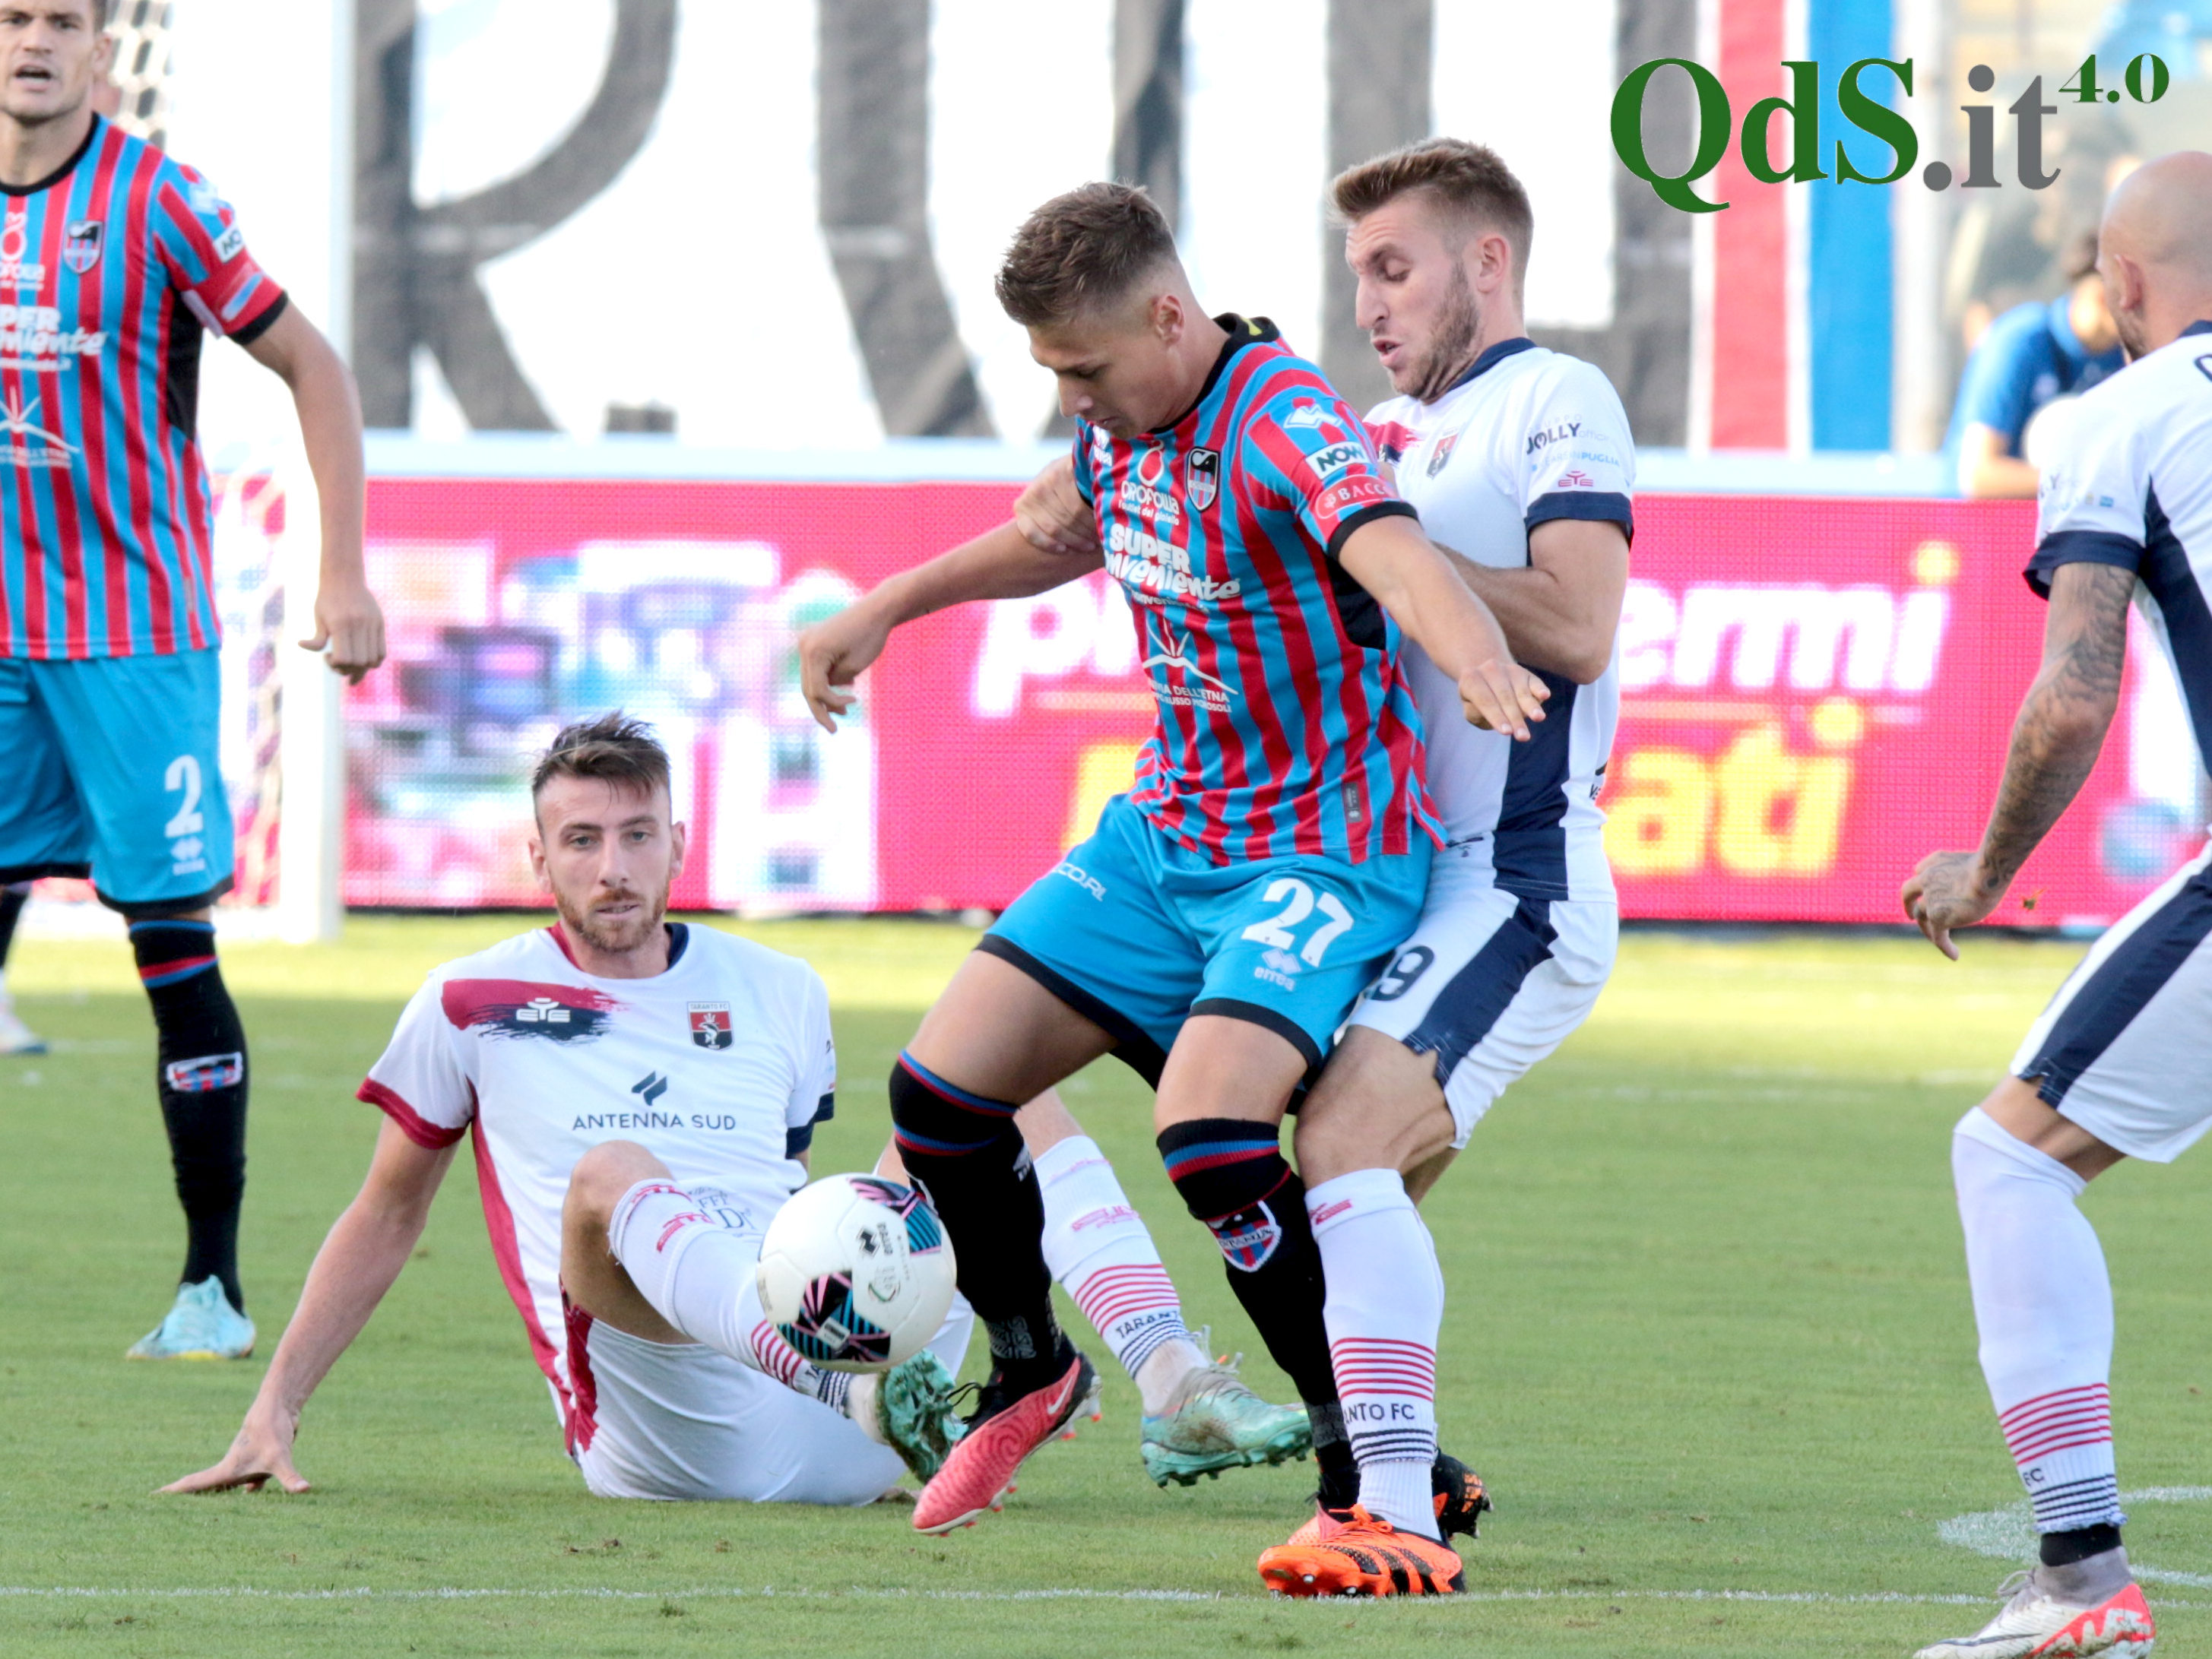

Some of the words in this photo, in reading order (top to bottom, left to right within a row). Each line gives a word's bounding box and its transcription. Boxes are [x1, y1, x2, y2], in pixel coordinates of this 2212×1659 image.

[1526, 423, 1581, 455] JOLLY
[1316, 445, 1366, 472] NOW
[1338, 483, 1391, 501] BACC
[1109, 523, 1192, 575] SUPER
[165, 755, 204, 837] 2
[1241, 878, 1354, 967] 27
[572, 1113, 684, 1131] ANTENNA
[691, 1114, 736, 1131] SUD
[1391, 1403, 1415, 1421] FC
[2022, 1467, 2045, 1487] FC
